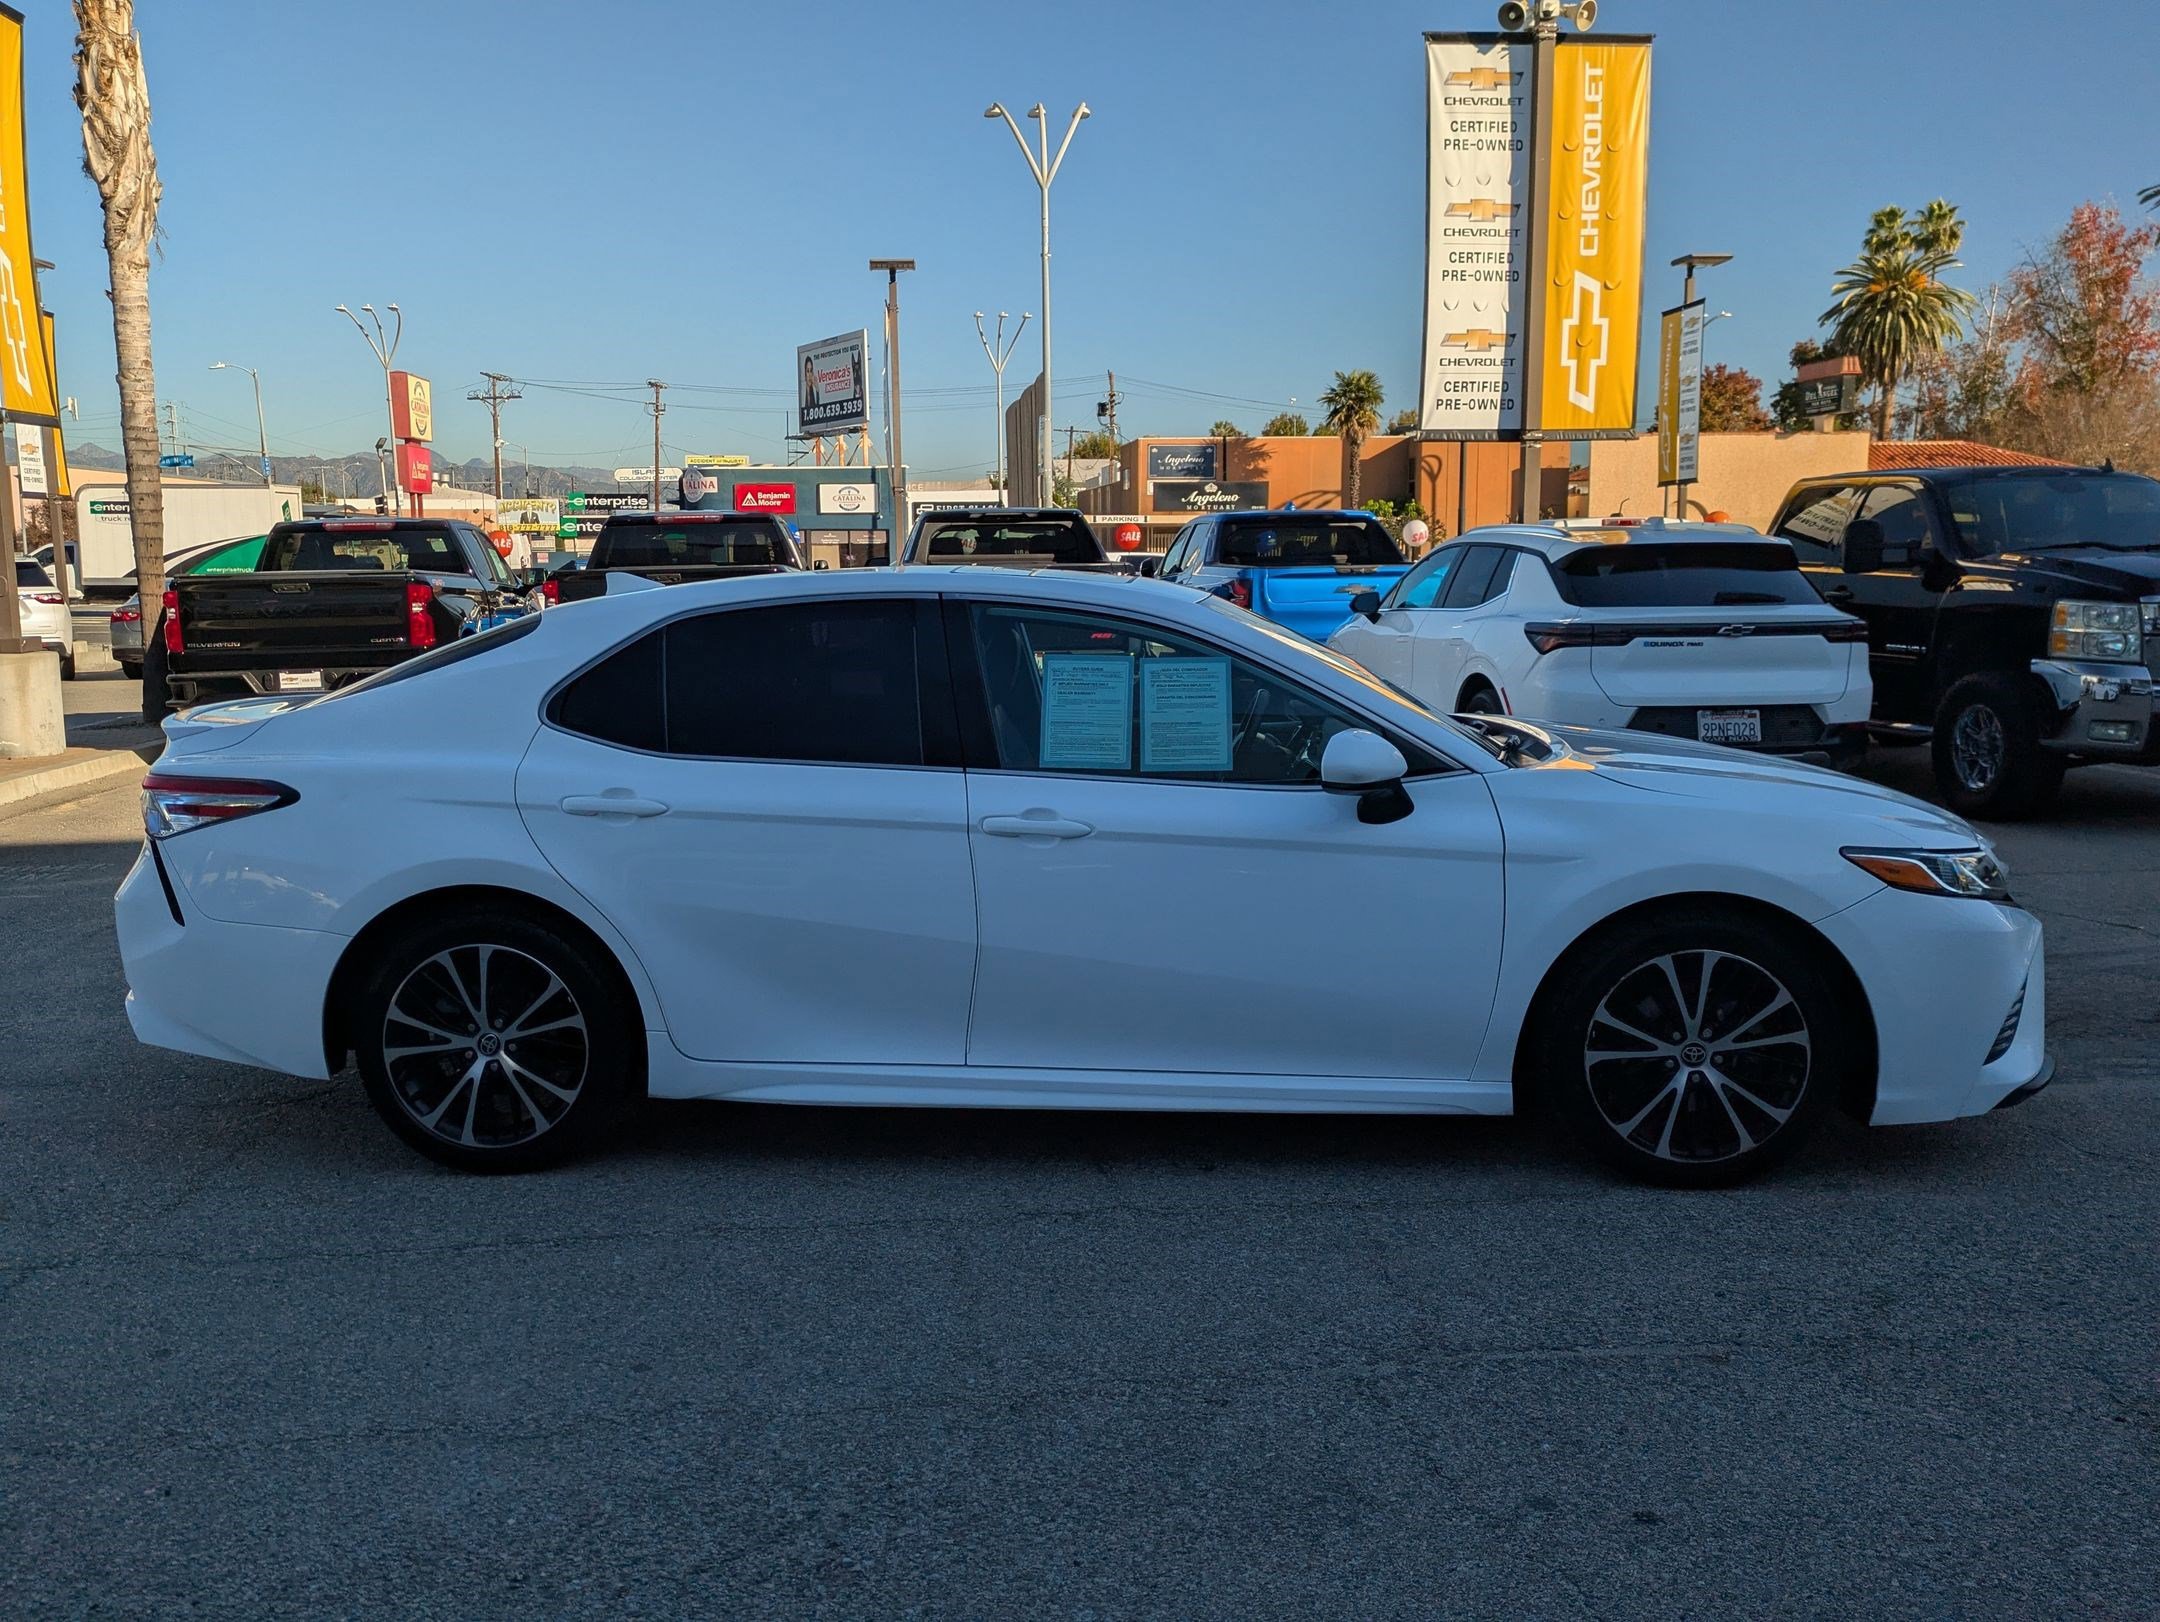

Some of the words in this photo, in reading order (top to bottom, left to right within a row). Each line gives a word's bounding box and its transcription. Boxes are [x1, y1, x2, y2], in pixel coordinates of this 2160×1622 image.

[1444, 96, 1524, 107] CHEVROLET
[1450, 120, 1518, 134] CERTIFIED
[1443, 138, 1524, 152] PRE-OWNED
[1579, 62, 1604, 257] CHEVROLET
[1443, 227, 1521, 238] CHEVROLET
[1448, 251, 1514, 265] CERTIFIED
[1441, 268, 1520, 282] PRE-OWNED
[1439, 357, 1516, 367] CHEVROLET
[817, 364, 851, 383] Veronica's
[1443, 381, 1509, 394] CERTIFIED
[803, 400, 862, 421] 1.800.639.3939
[1436, 398, 1515, 411] PRE-OWNED
[1158, 453, 1205, 466] Angeleno
[573, 496, 648, 508] enterprise
[757, 492, 791, 501] Benjamin
[1181, 490, 1241, 506] Angeleno
[101, 514, 122, 522] truck
[498, 524, 558, 532] 818-777-7777
[563, 521, 604, 532] ente
[493, 534, 512, 549] ALE
[1119, 530, 1141, 541] SALE
